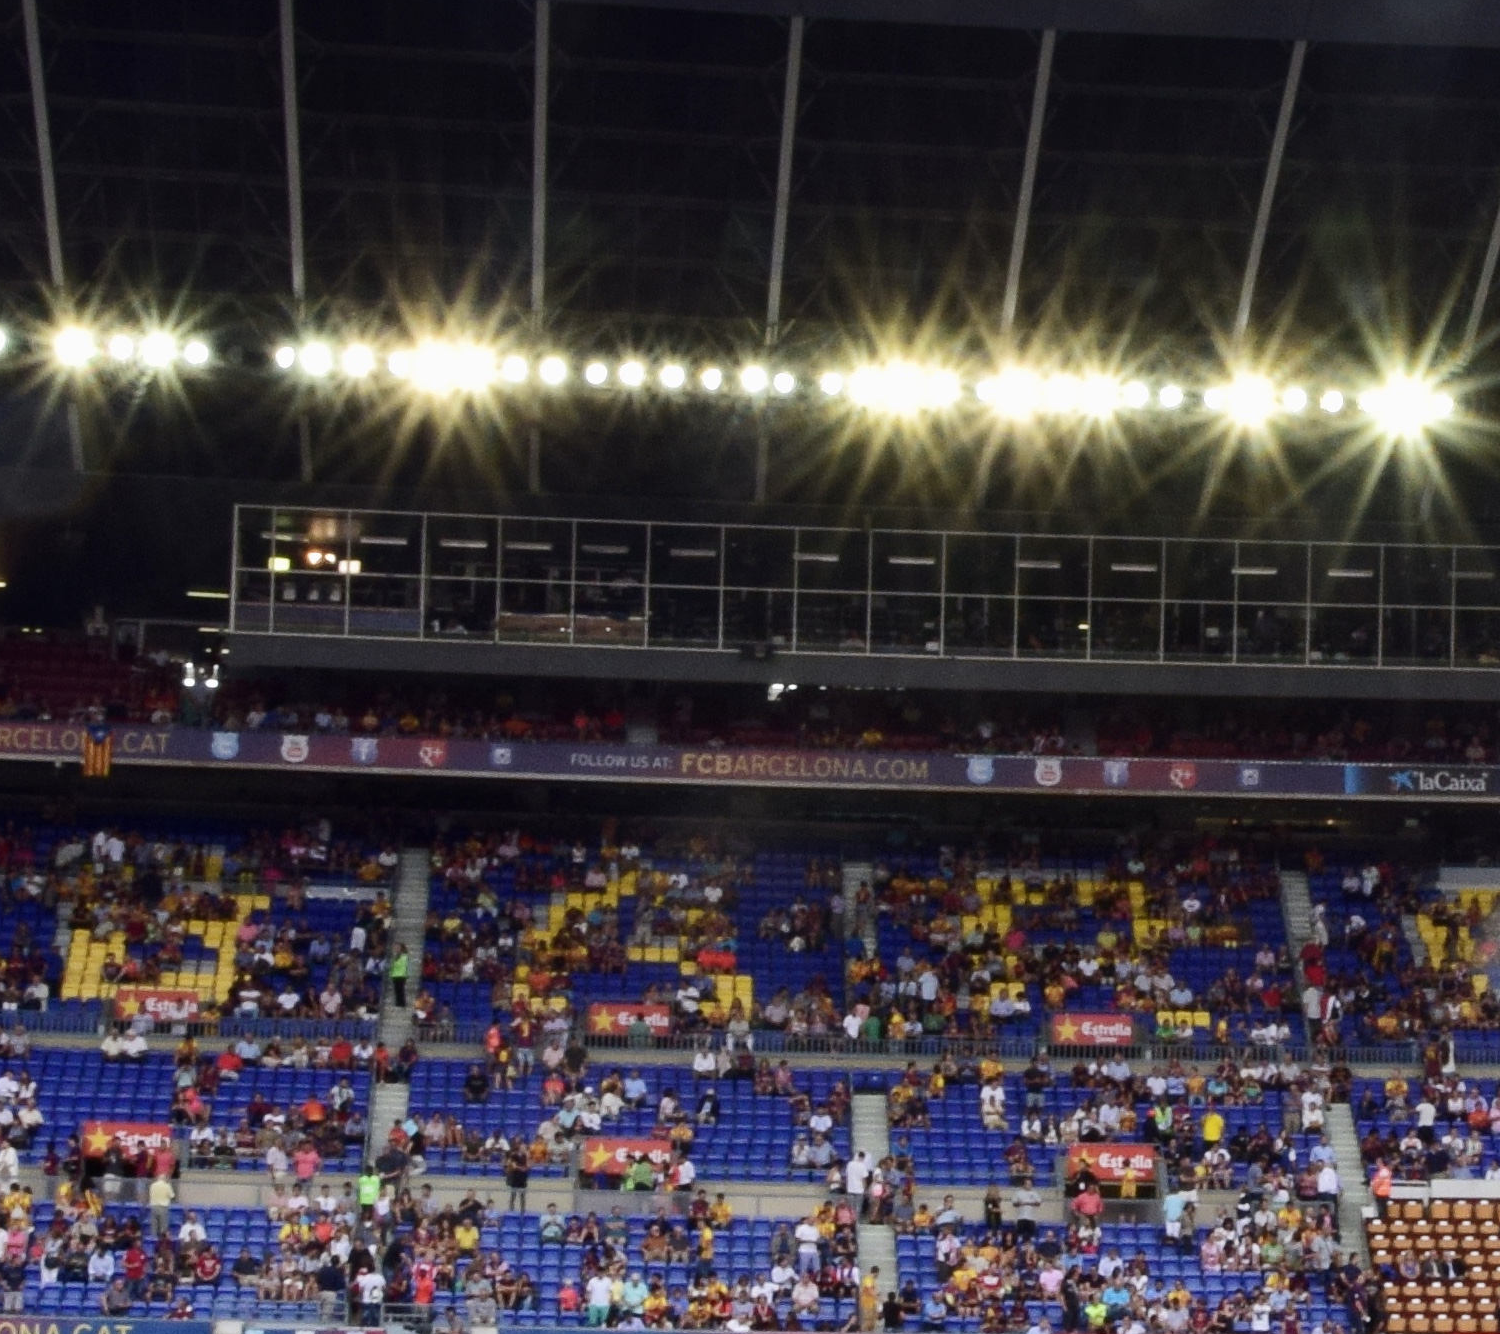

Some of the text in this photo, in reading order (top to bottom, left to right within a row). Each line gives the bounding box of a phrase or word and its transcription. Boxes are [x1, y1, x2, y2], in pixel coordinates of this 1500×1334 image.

[570, 752, 626, 767] FOLLOW
[630, 755, 649, 768] US
[681, 753, 929, 780] FCBARCELONA.COM
[1082, 1022, 1132, 1037] Estrella
